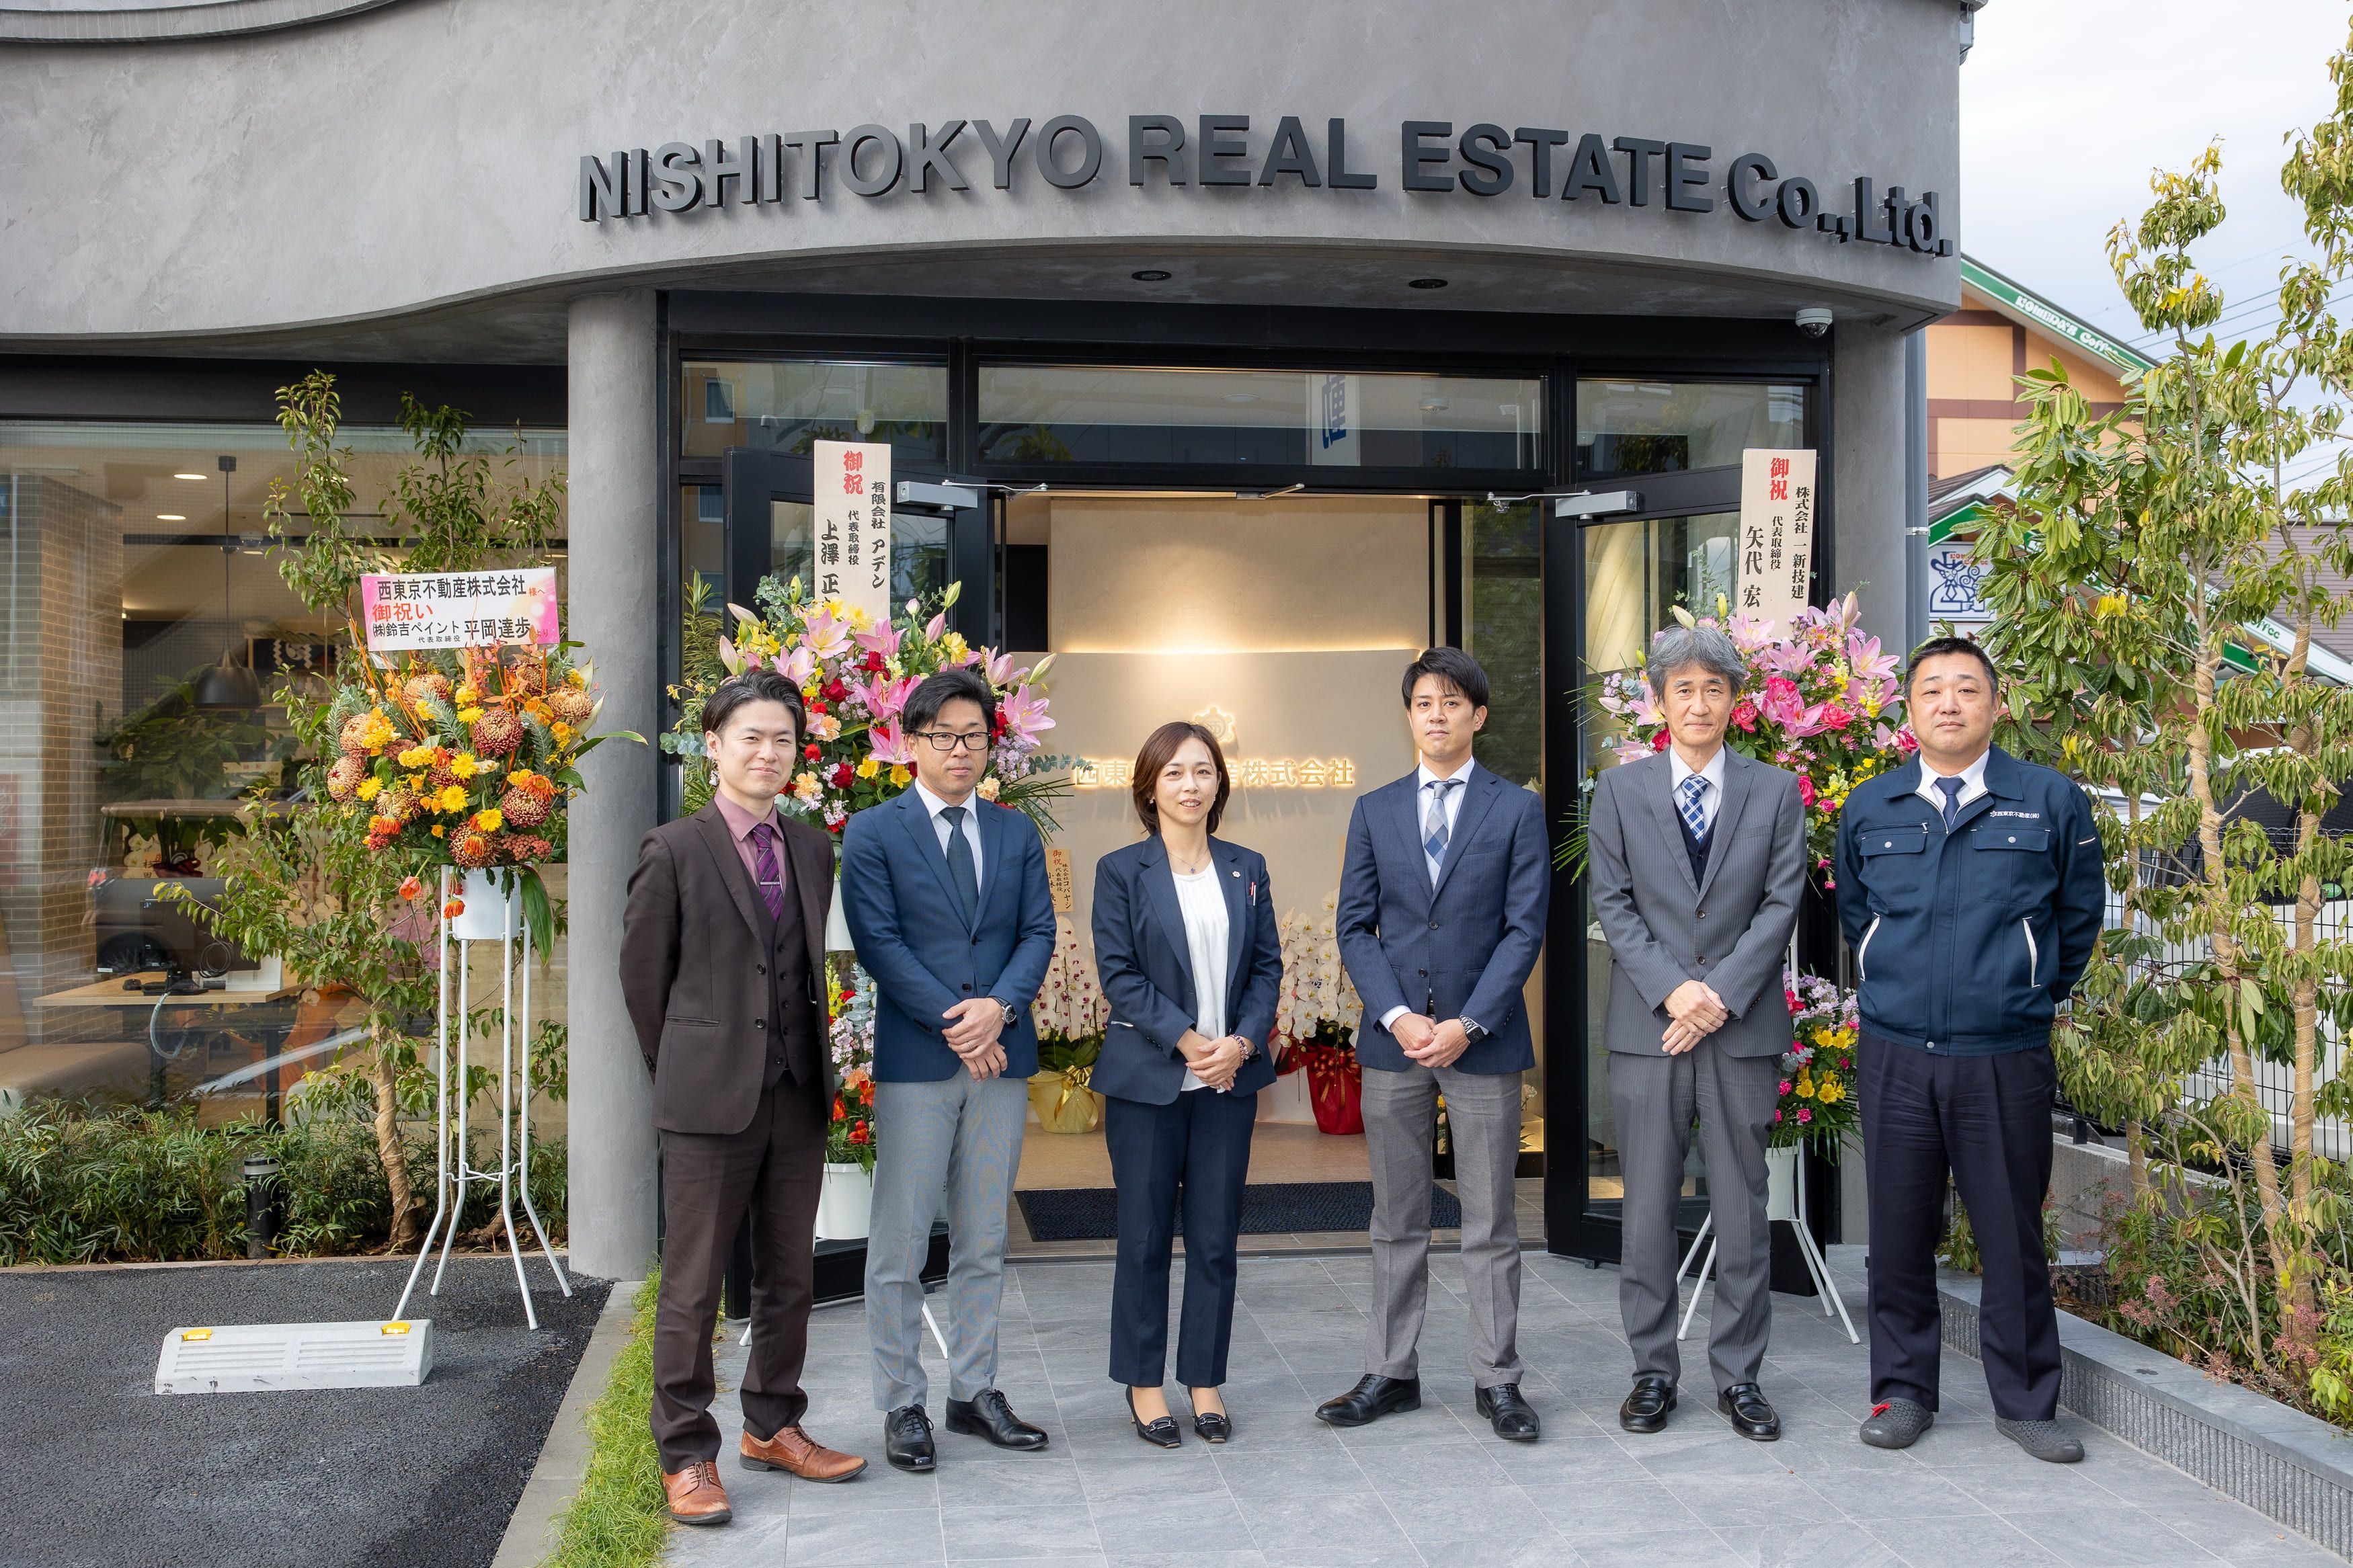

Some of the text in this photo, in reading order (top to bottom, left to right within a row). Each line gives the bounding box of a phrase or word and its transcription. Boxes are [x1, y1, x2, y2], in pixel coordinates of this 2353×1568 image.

[580, 114, 1103, 223] NISHITOKYO
[1129, 114, 1377, 190] REAL
[1401, 121, 1714, 213] ESTATE
[843, 451, 863, 495] 御祝
[1769, 458, 1790, 501] 御祝
[848, 510, 859, 565] 代表取締役
[871, 481, 886, 589] 有限会社 アデン
[1770, 516, 1782, 570] 代表取締役
[377, 575, 526, 600] 西東京不動産株式会社
[822, 573, 840, 607] 正
[372, 603, 433, 622] 御祝い
[465, 617, 530, 640] 平岡達歩
[418, 635, 461, 643] 代表取締役
